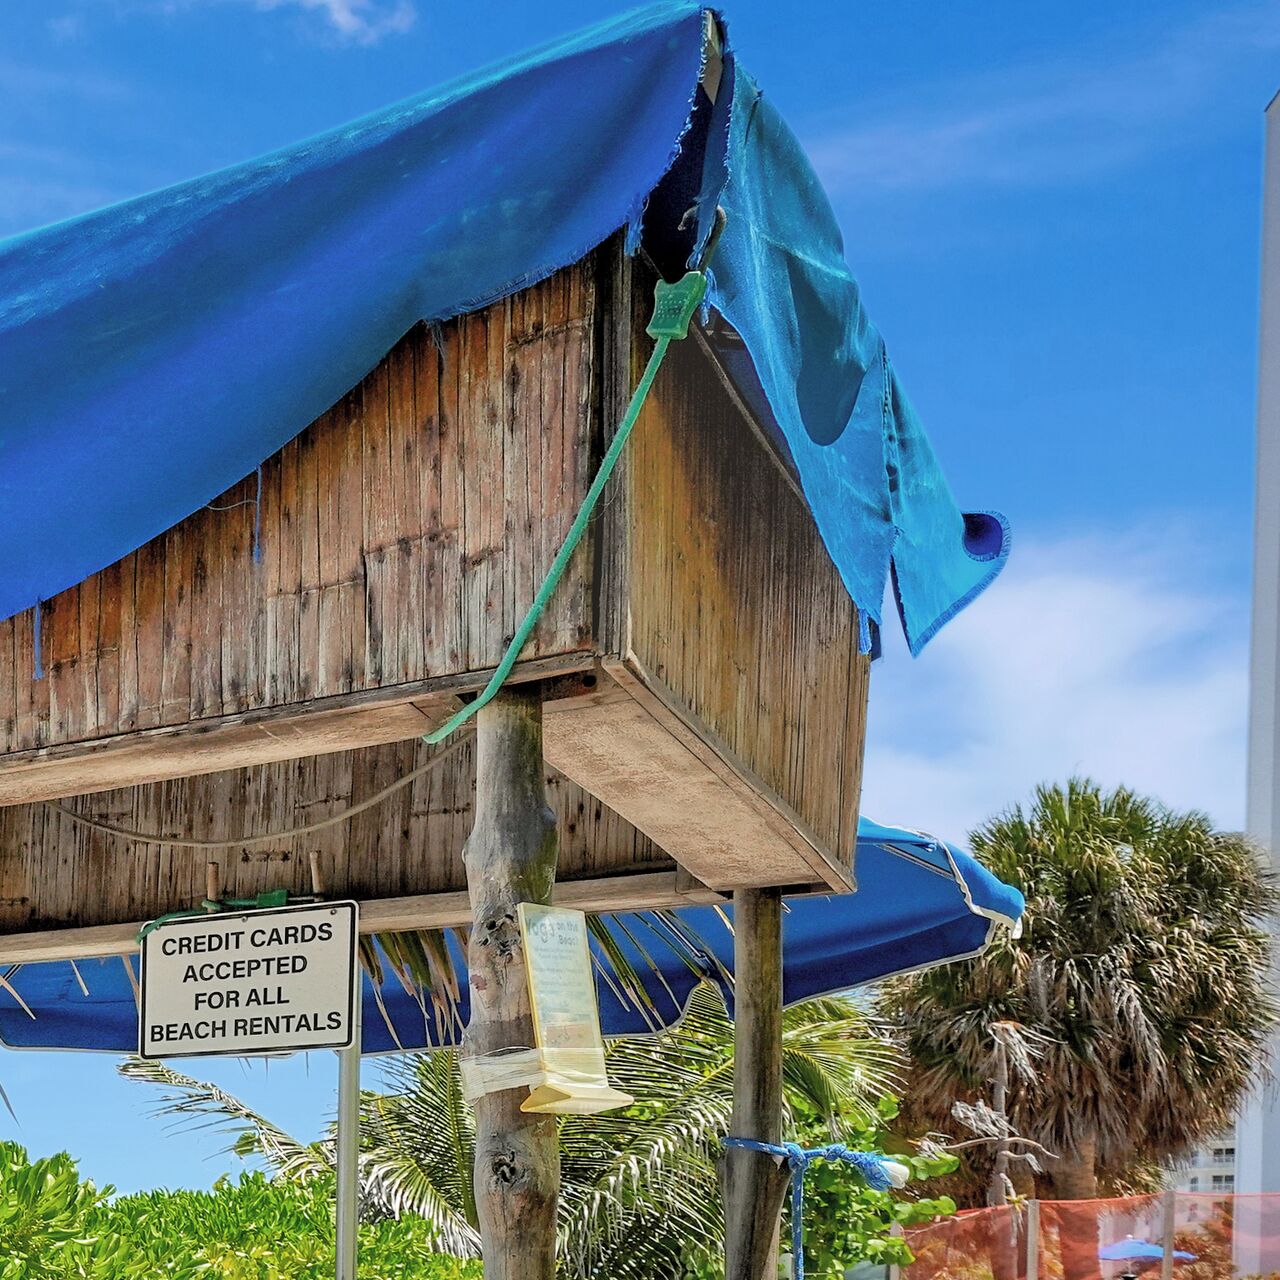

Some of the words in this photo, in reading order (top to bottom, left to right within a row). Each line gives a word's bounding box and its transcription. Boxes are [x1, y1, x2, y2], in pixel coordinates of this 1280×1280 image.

[162, 931, 244, 955] CREDIT
[250, 923, 332, 947] CARDS
[183, 955, 307, 983] ACCEPTED
[195, 991, 239, 1010] FOR
[245, 987, 289, 1007] ALL
[150, 1020, 226, 1042] BEACH
[234, 1011, 341, 1036] RENTALS
